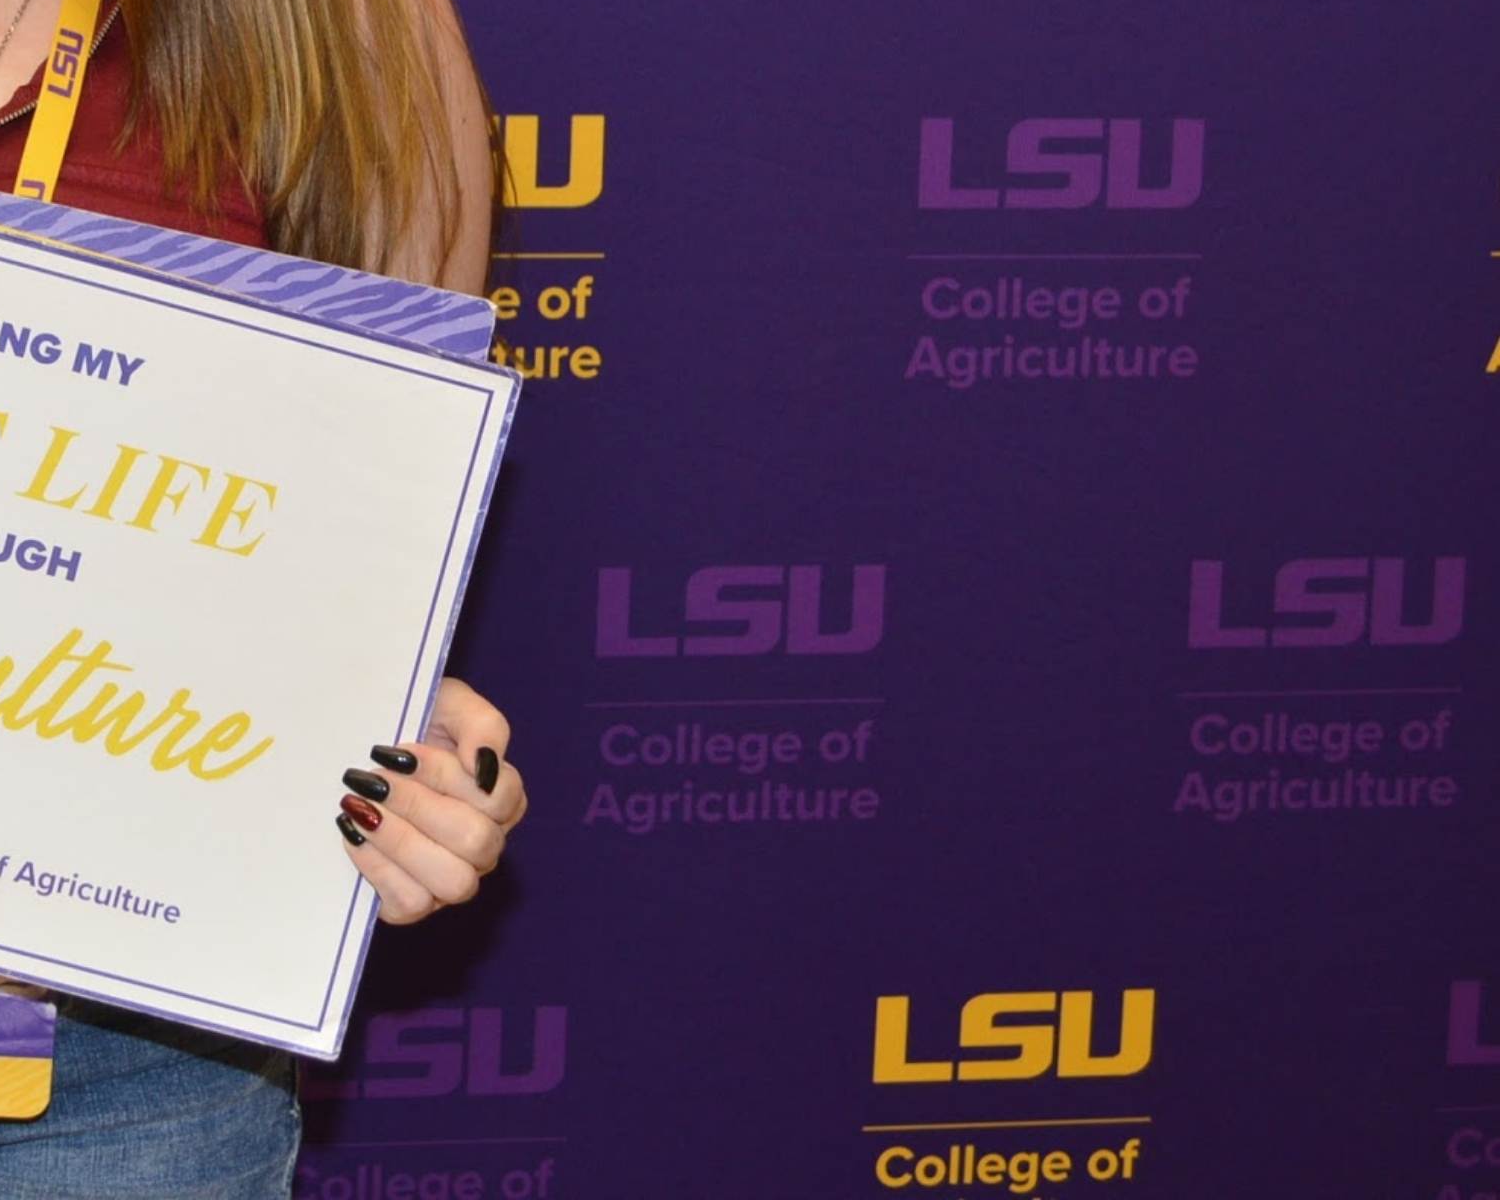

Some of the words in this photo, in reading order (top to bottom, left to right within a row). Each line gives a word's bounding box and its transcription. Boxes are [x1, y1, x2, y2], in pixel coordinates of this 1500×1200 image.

[46, 28, 84, 99] LSU
[918, 117, 1206, 210] LSU
[537, 275, 594, 320] of
[921, 276, 1122, 330] College
[1138, 276, 1191, 319] of
[73, 342, 145, 387] MY
[904, 334, 1199, 390] Agriculture
[15, 425, 278, 558] LIFE
[596, 564, 887, 657] LSU
[1187, 556, 1466, 649] LSU
[600, 722, 803, 775] College
[818, 720, 873, 763] of
[1189, 712, 1384, 763] College
[1398, 709, 1452, 751] of
[582, 769, 880, 834] Agriculture
[1172, 764, 1458, 823] Agriculture
[14, 858, 182, 925] Agriculture
[872, 988, 1155, 1084] LSU
[500, 1158, 555, 1200] of
[875, 1144, 1072, 1194] College
[1087, 1138, 1141, 1181] of
